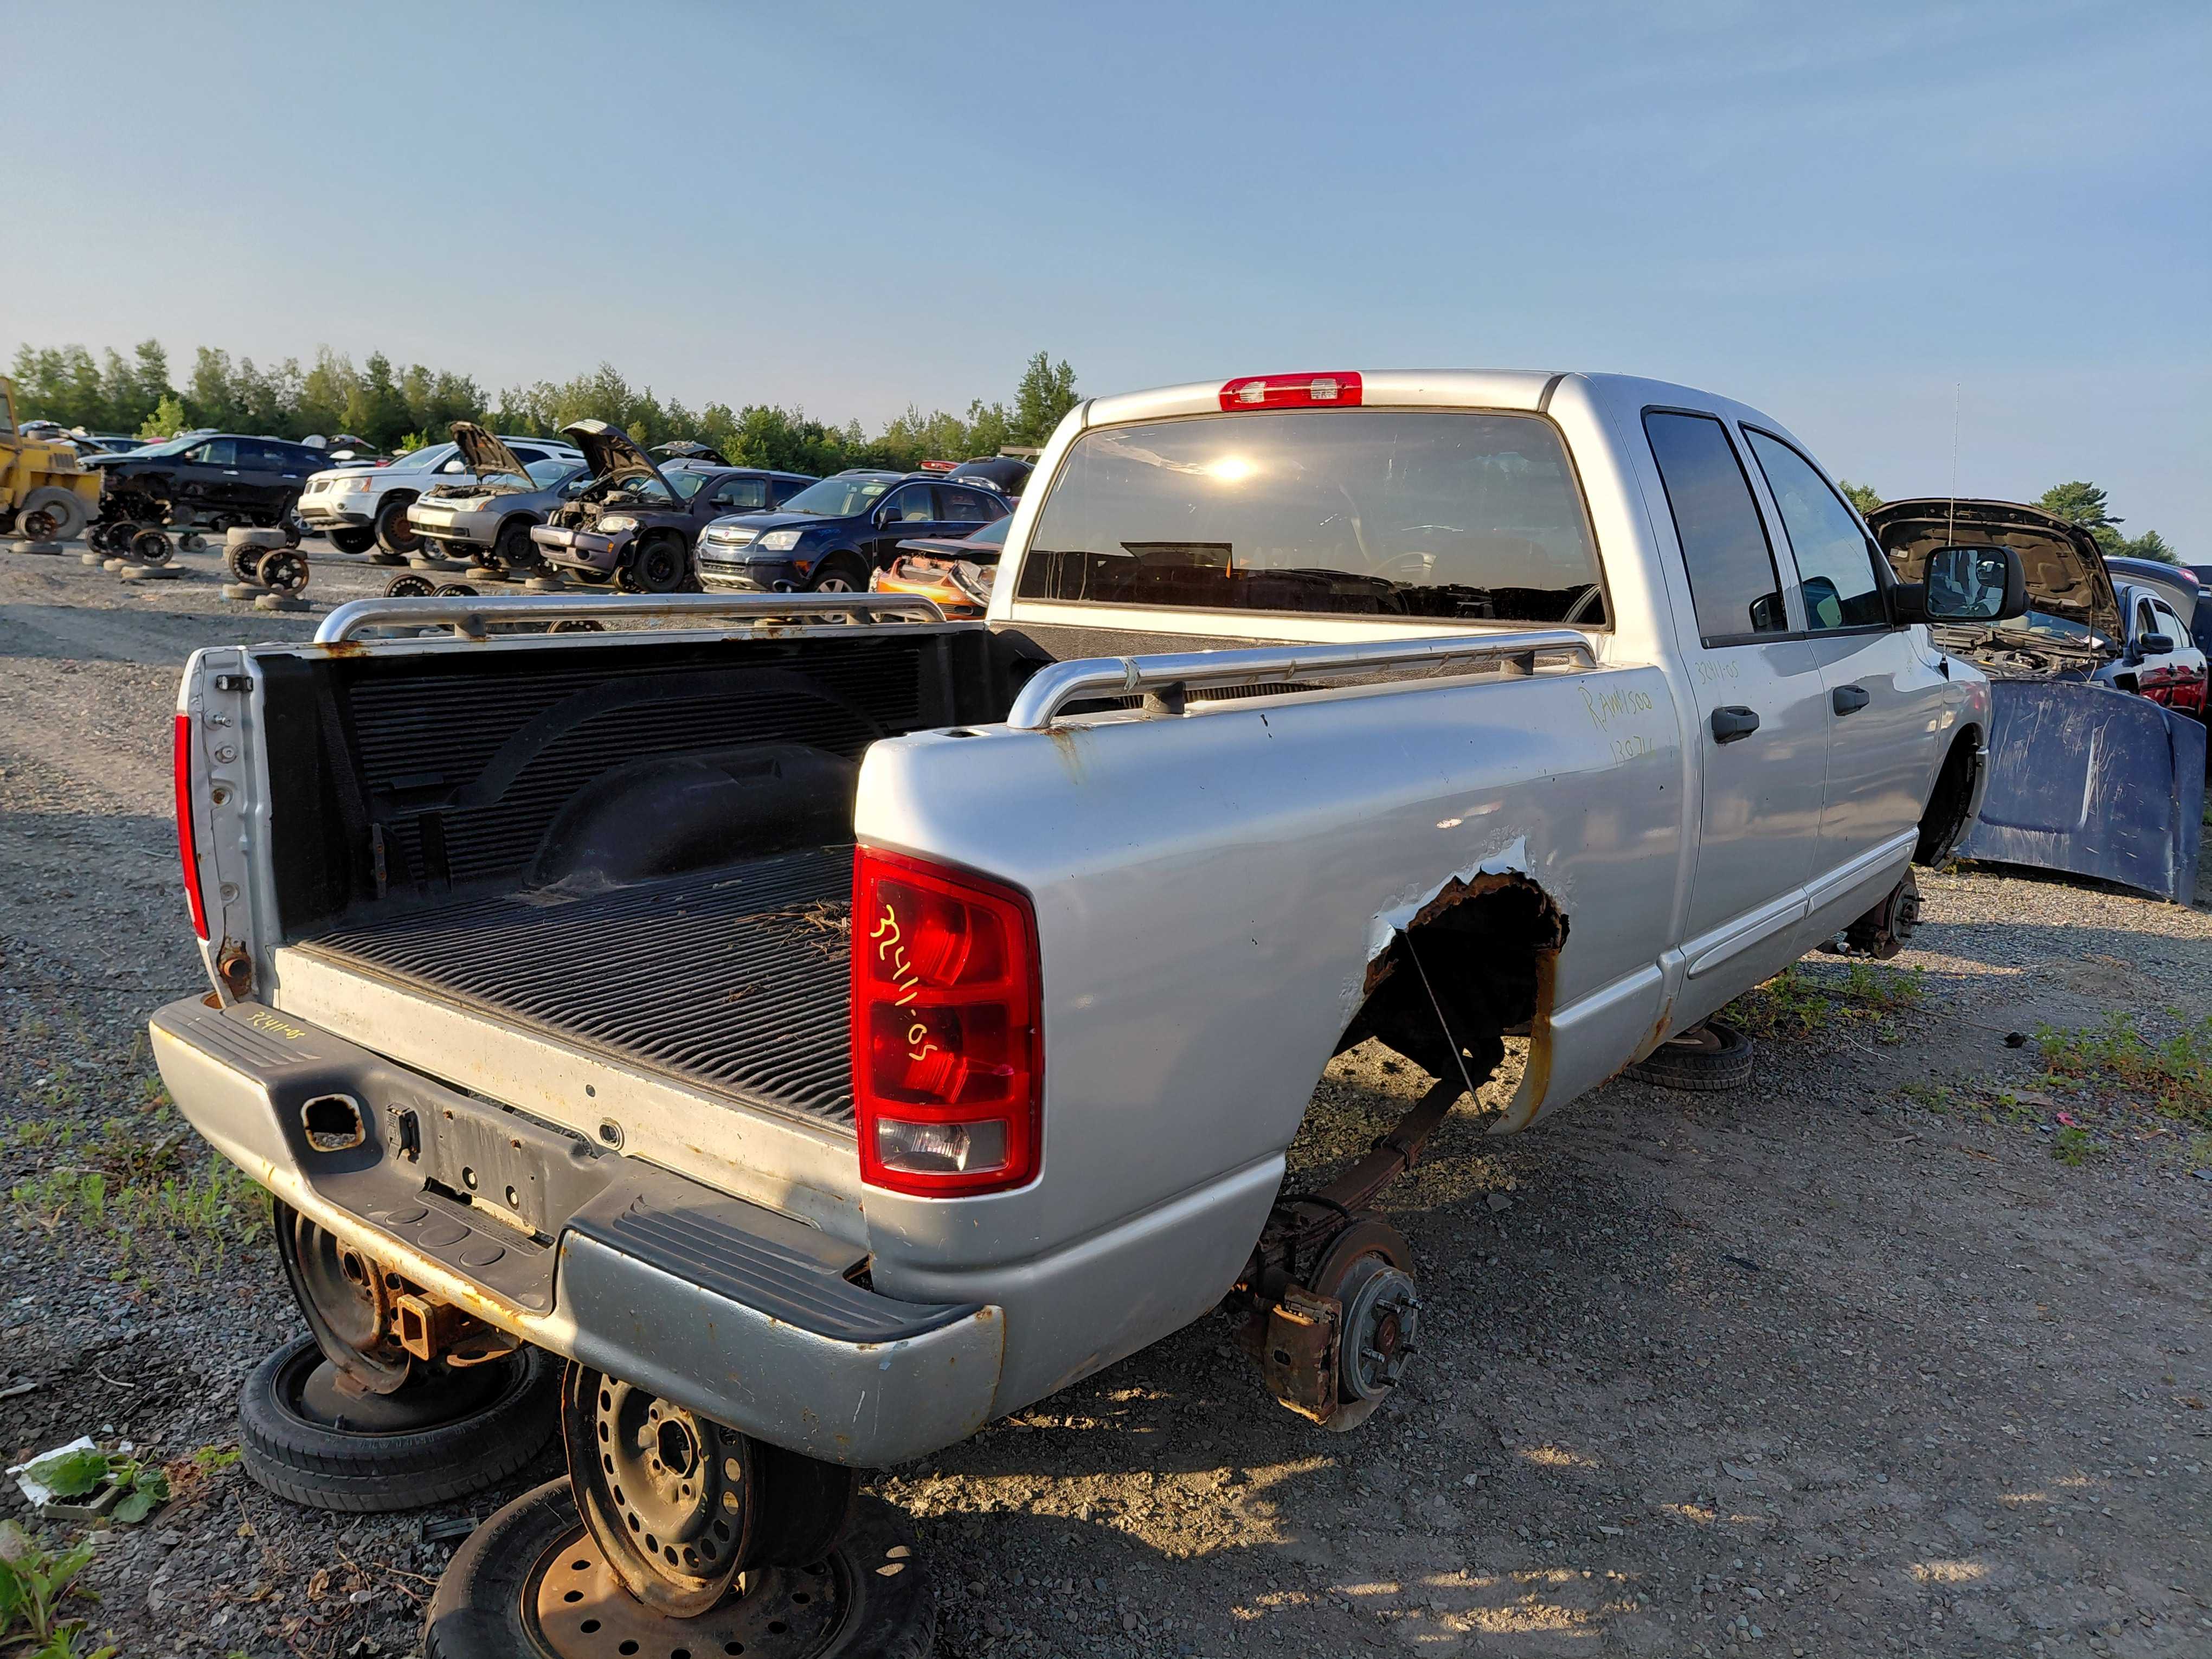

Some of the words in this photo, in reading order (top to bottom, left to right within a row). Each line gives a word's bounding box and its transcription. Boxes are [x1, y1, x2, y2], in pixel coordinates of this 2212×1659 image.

[1695, 660, 1739, 685] 32411-05
[870, 904, 938, 1061] 32411-05
[246, 1011, 307, 1040] 32411-05
